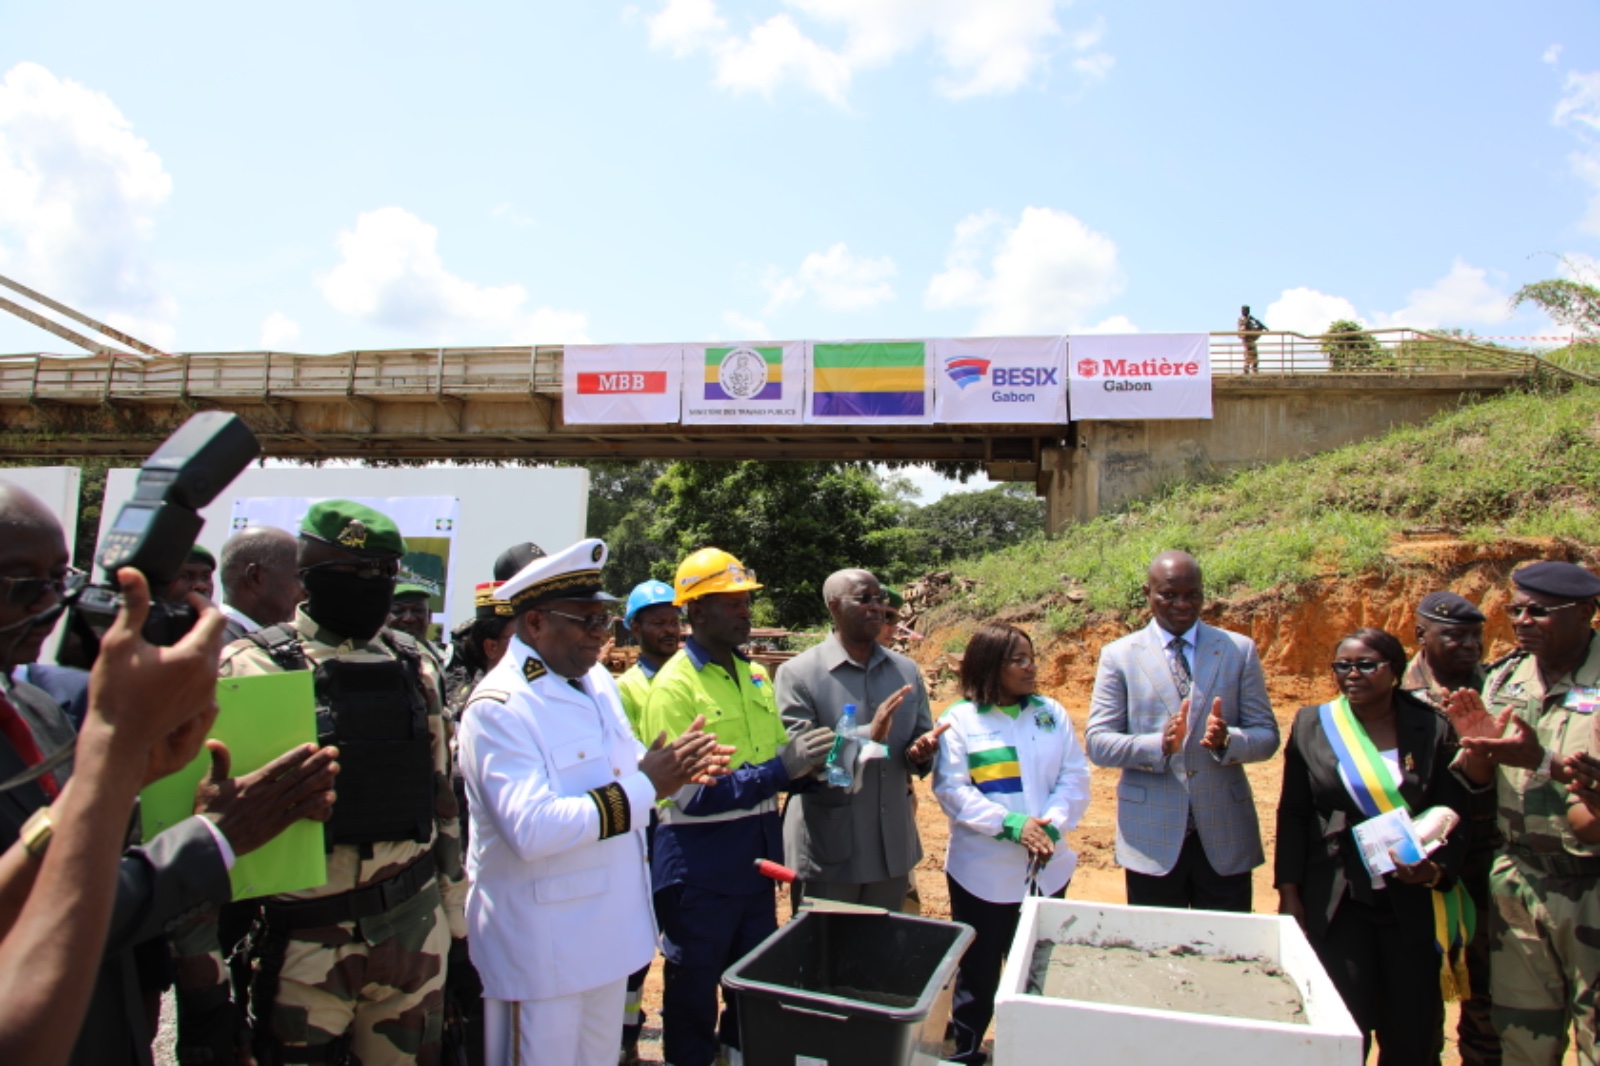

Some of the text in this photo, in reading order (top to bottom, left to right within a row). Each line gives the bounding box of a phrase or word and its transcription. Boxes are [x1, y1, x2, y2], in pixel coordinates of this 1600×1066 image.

[1102, 358, 1199, 376] Matière
[598, 374, 645, 391] MBB
[992, 367, 1058, 386] BESIX
[1103, 380, 1152, 391] Gabon
[992, 391, 1035, 402] Gabon
